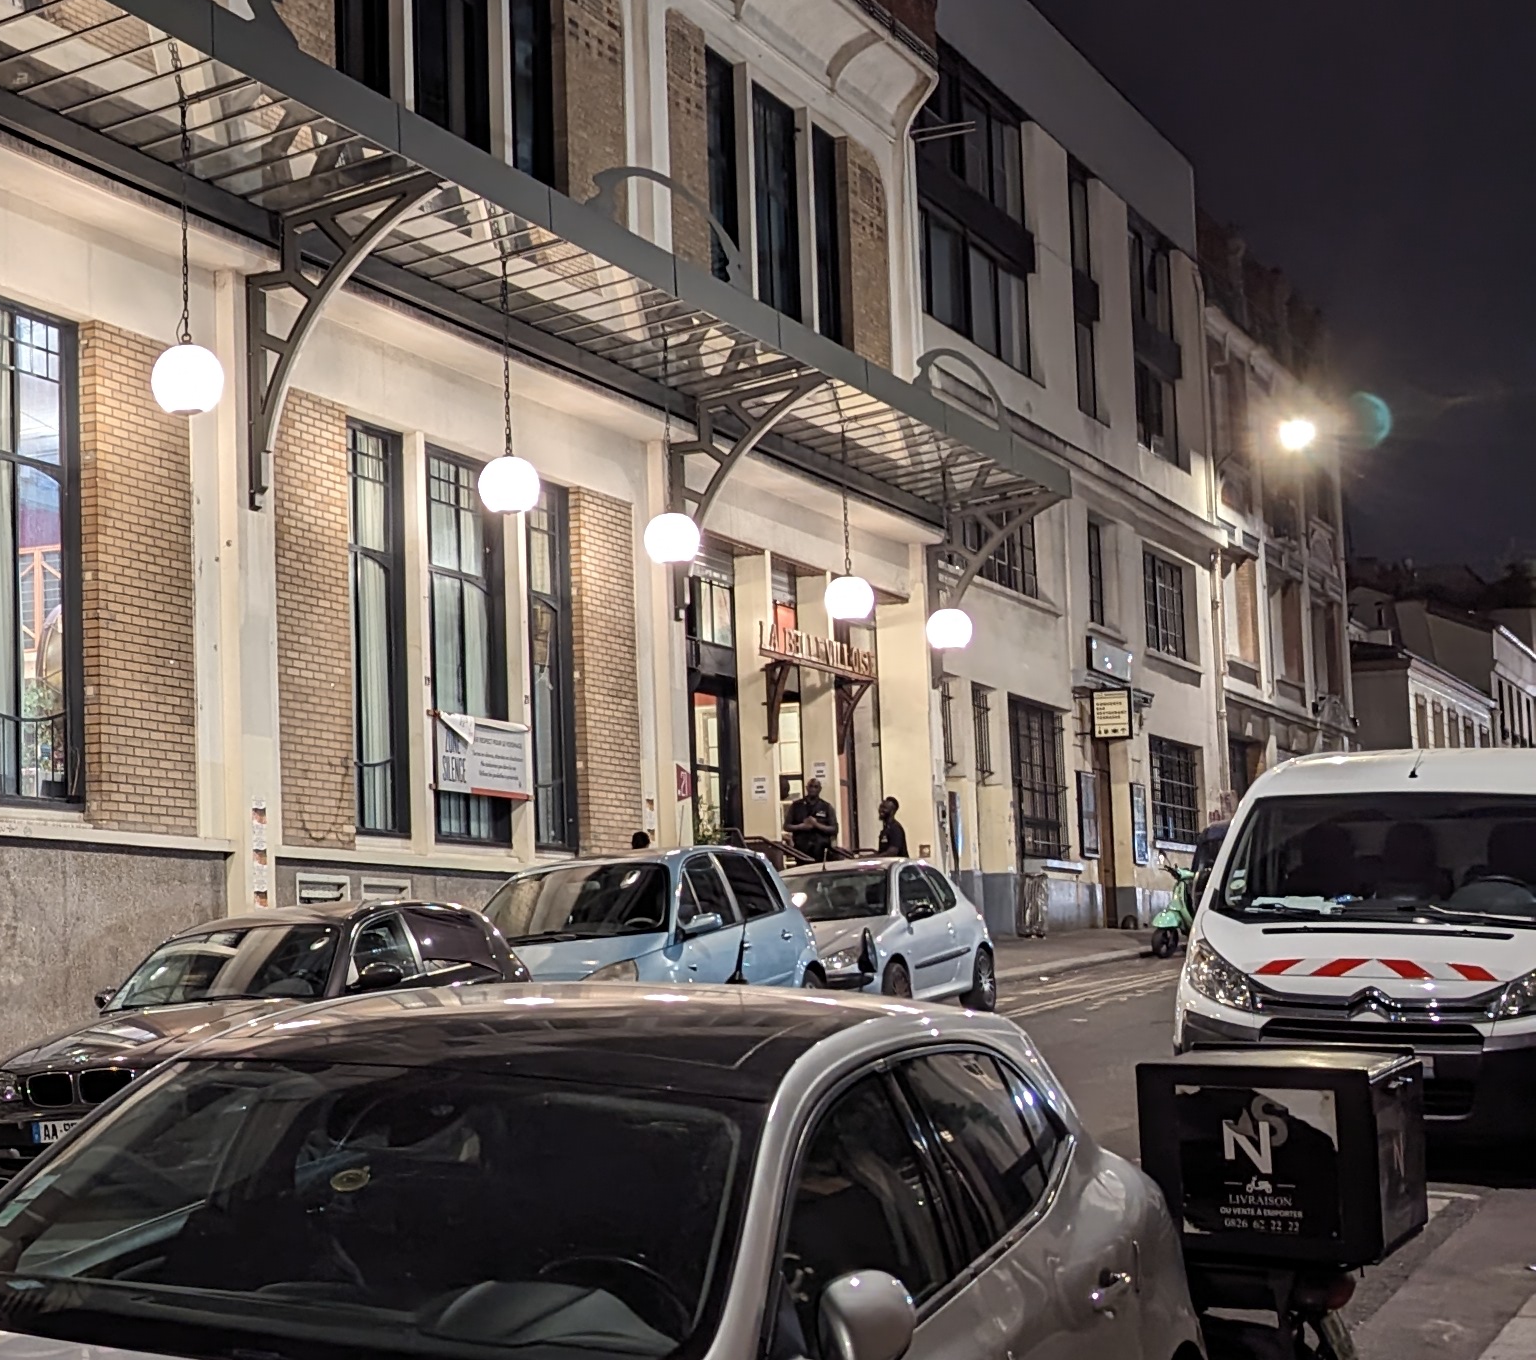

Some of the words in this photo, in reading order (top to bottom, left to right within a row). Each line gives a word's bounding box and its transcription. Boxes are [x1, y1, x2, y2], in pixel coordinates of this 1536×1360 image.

[759, 621, 780, 652] LA
[1229, 1194, 1293, 1207] LIVRAISON
[1220, 1207, 1232, 1215] OU
[1233, 1208, 1256, 1216] VENTE
[1263, 1209, 1303, 1219] EMPORTER
